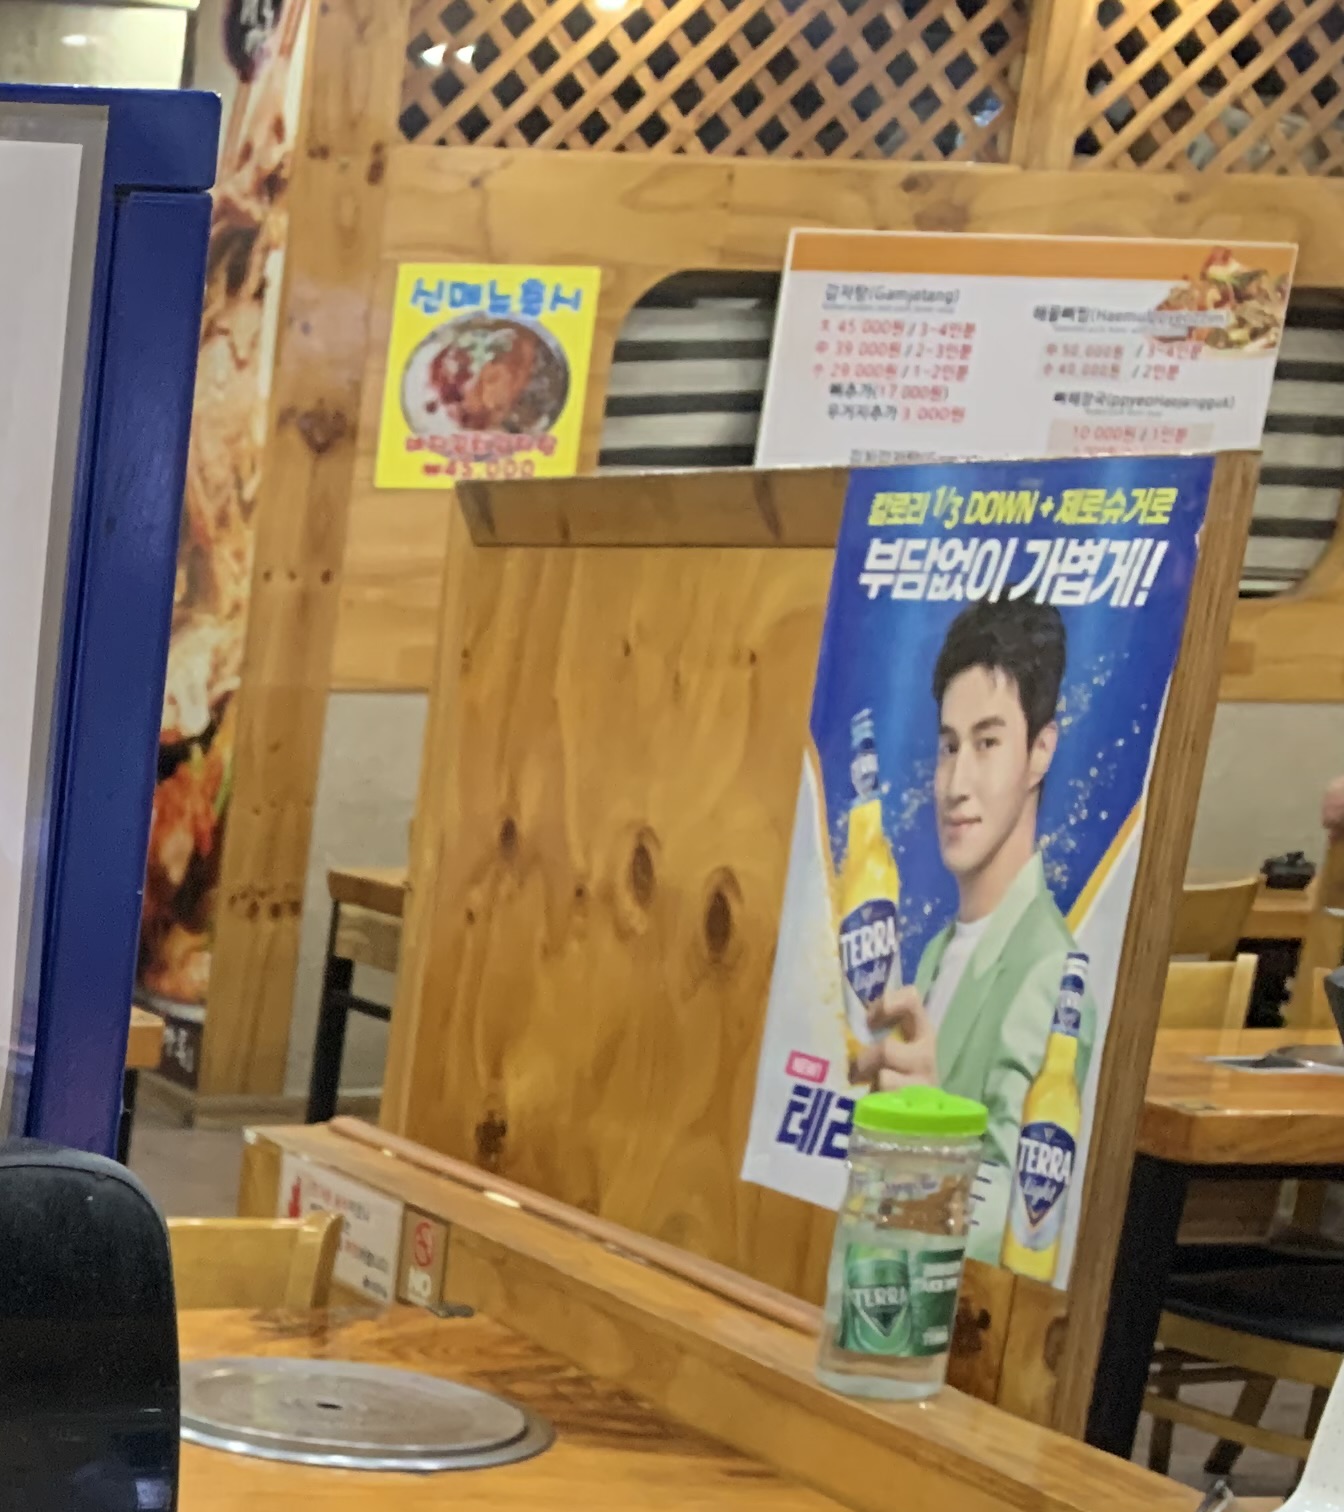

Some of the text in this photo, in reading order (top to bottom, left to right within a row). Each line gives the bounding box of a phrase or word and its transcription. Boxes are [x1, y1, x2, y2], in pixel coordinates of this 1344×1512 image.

[964, 490, 1039, 525] DOWN
[859, 537, 1169, 608] 부담없이 가볍게!
[840, 916, 897, 973] TERRA
[1019, 1136, 1072, 1185] TERRA
